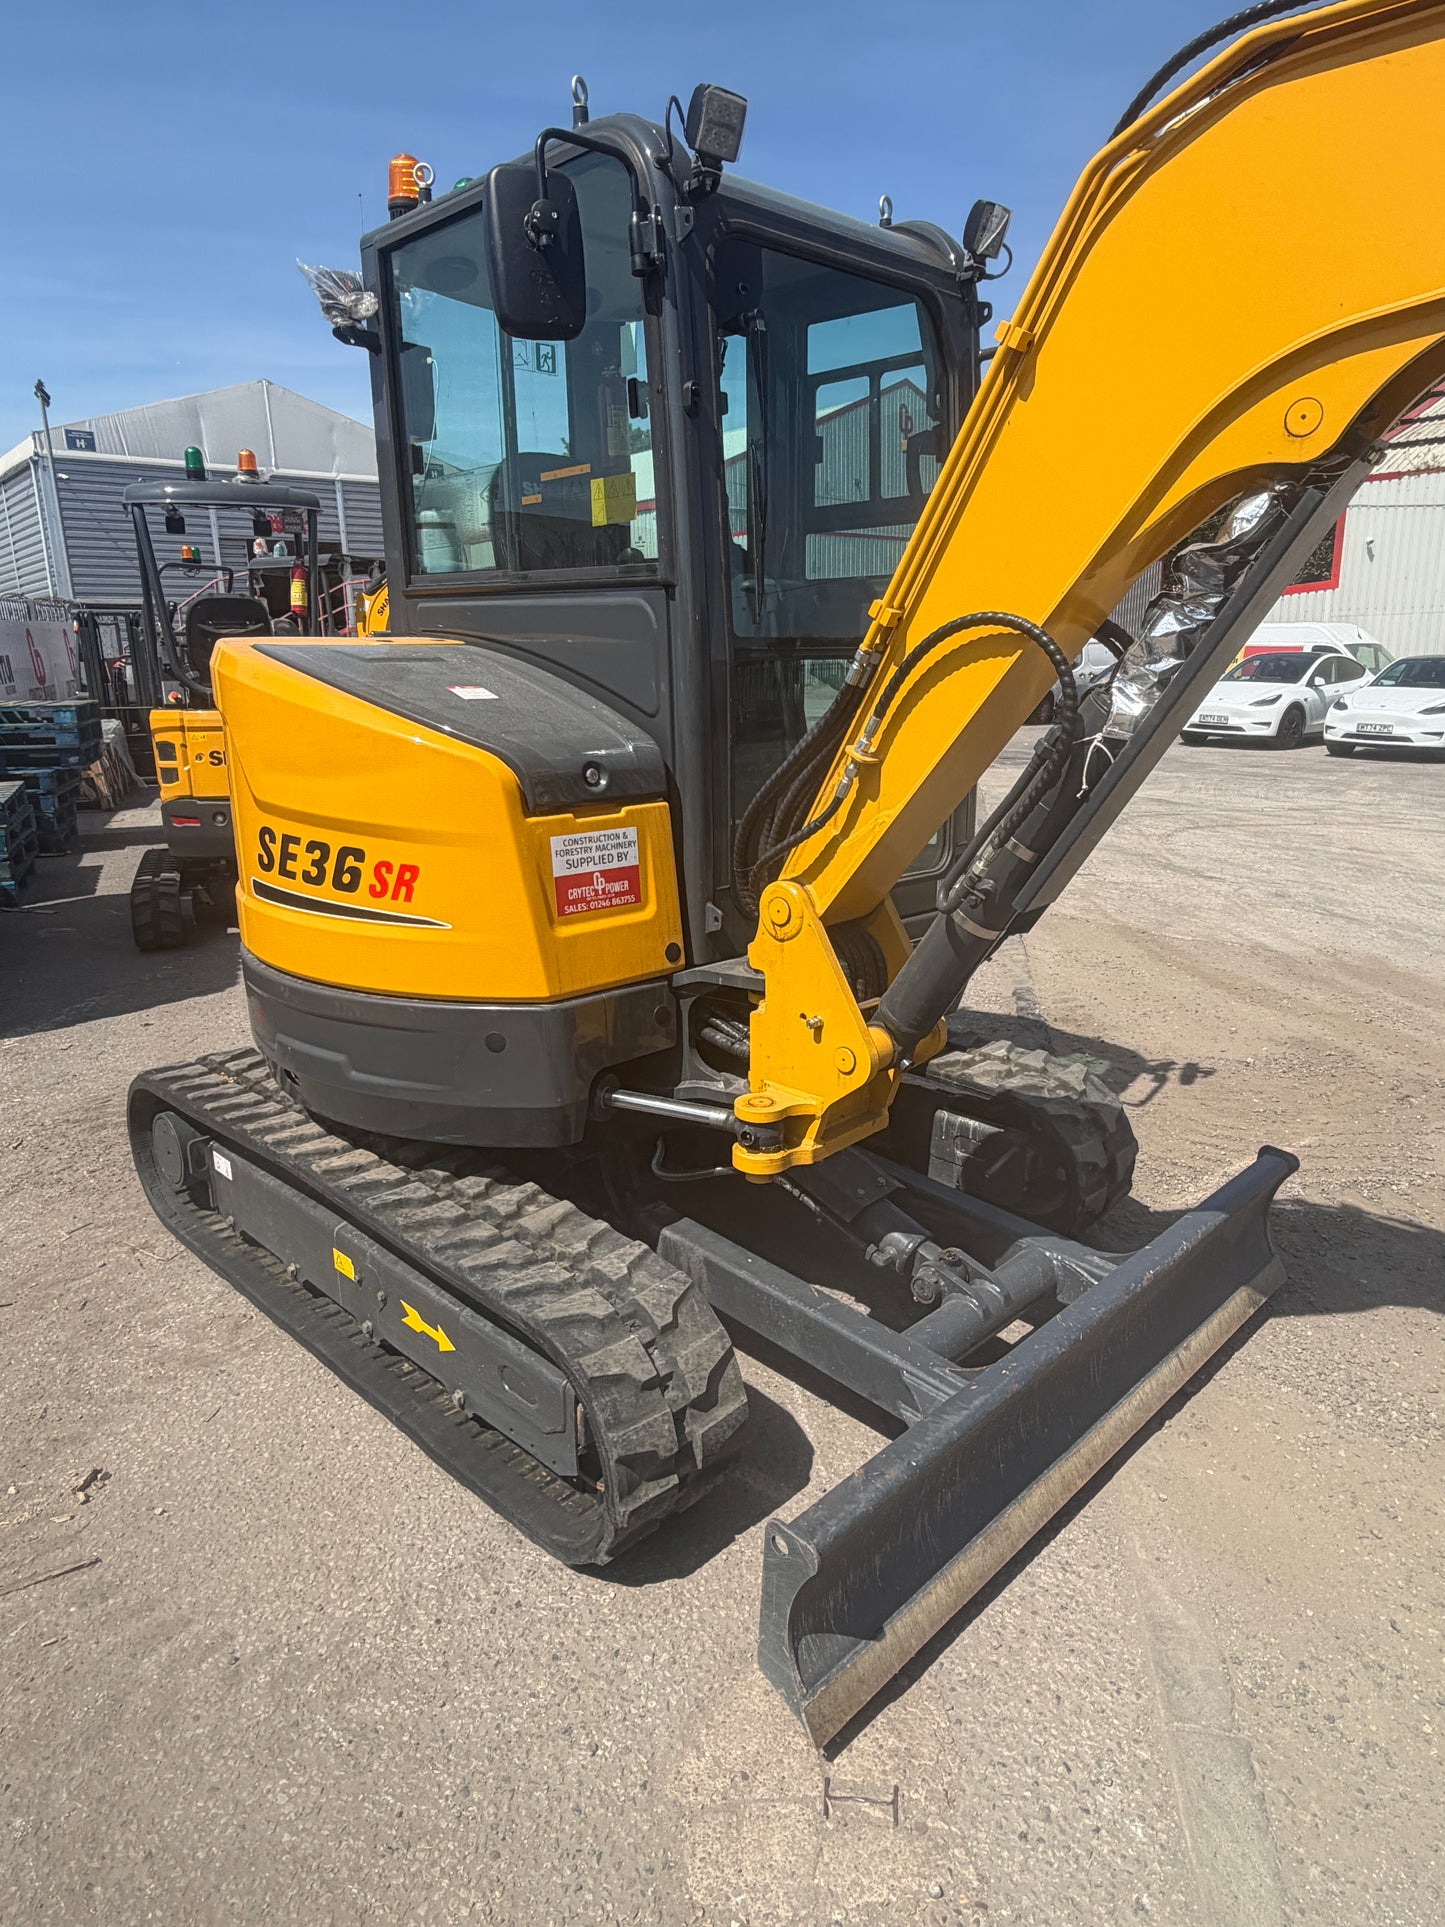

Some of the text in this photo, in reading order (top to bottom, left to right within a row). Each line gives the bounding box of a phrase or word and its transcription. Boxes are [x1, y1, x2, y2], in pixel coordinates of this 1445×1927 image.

[555, 840, 636, 858] FORESTRY MACHINERY
[563, 832, 628, 847] CONSTRUCTION &
[257, 826, 421, 904] SE36 SR
[566, 851, 629, 870] SUPPLIED BY
[568, 886, 594, 900] CRYTEC
[606, 880, 629, 894] POWER
[564, 904, 589, 914] SALES:
[590, 898, 610, 909] 01246
[612, 894, 636, 906] 863755
